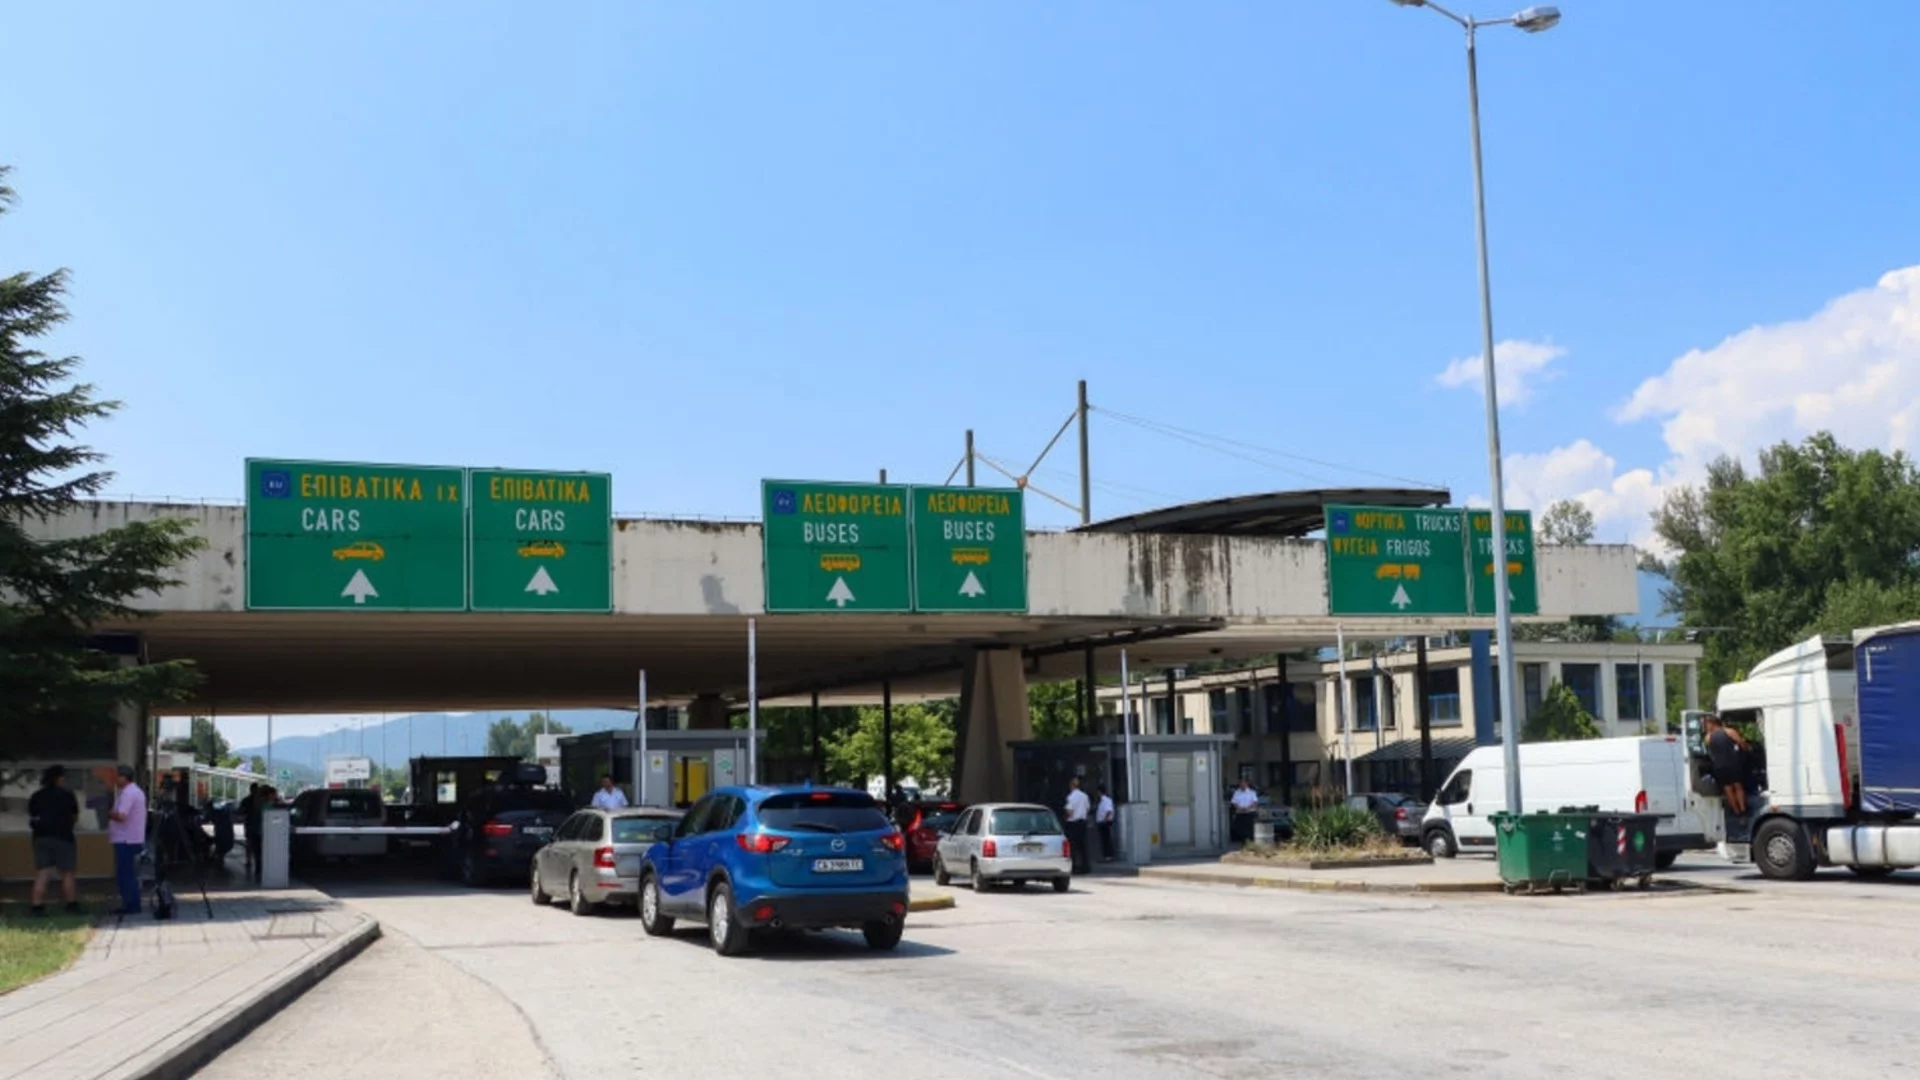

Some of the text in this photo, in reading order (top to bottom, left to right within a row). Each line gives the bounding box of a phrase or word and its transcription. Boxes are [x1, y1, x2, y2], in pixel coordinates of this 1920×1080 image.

[301, 473, 423, 501] ΕΠΙΒΑΤΙΚΑ
[490, 476, 590, 503] ΕΠΙΒΑΤΙΚΑ
[301, 507, 361, 532] CARS
[515, 507, 566, 532] CARS
[943, 519, 996, 541] BUSES
[1414, 513, 1461, 532] TRUCKS
[803, 521, 860, 543] BUSES
[1385, 538, 1431, 557] FRIGOS
